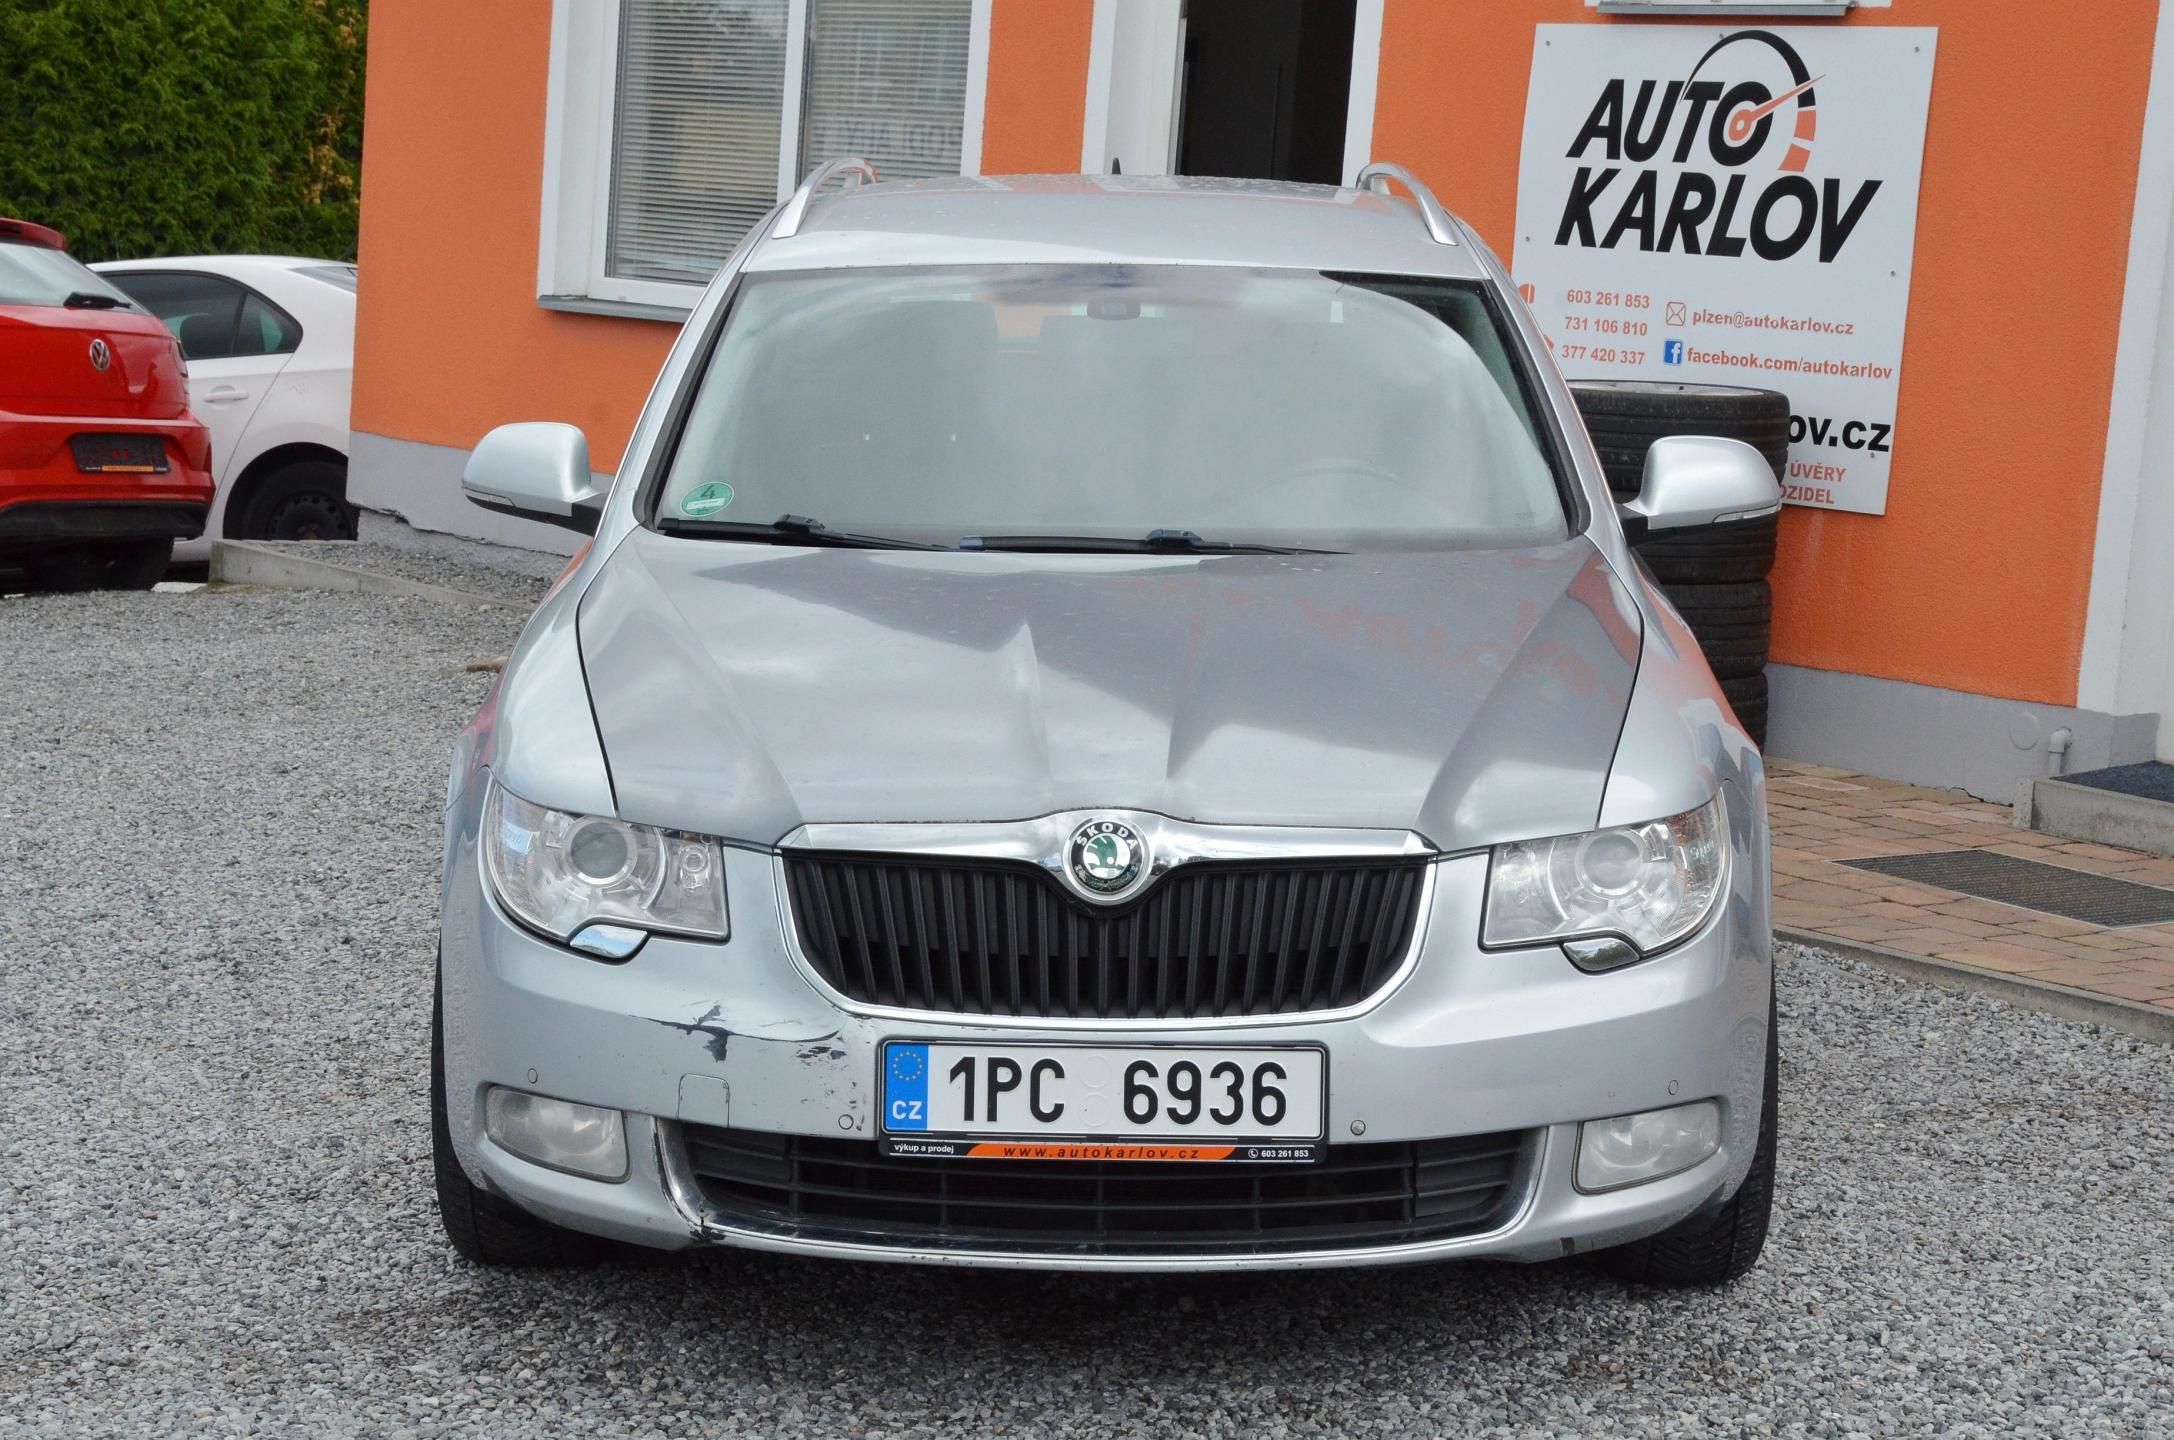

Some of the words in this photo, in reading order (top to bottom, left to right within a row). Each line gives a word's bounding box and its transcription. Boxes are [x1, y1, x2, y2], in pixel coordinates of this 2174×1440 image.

[1565, 78, 1774, 167] AUTO
[1554, 166, 1883, 263] KARLOV
[1566, 289, 1592, 304] 603
[1596, 291, 1620, 306] 261
[1624, 294, 1650, 309] 853
[1564, 316, 1588, 332] 731
[1594, 318, 1619, 334] 106
[1622, 321, 1648, 336] 810
[1691, 308, 1854, 336] plzen@autokarlov.cz
[1561, 344, 1588, 360] 377
[1590, 347, 1617, 363] 420
[1620, 350, 1646, 366] 337
[1687, 347, 1893, 379] facebook.com/autokarlov
[700, 484, 716, 499] 4
[949, 1056, 1065, 1123] 1PC
[1123, 1060, 1288, 1126] 6936
[892, 1100, 922, 1120] CZ
[894, 1143, 919, 1153] výkup
[928, 1144, 954, 1154] prodej
[1004, 1146, 1200, 1160] www.autokarlov.cz
[1261, 1149, 1276, 1158] 603
[1277, 1149, 1292, 1158] 261
[1294, 1149, 1309, 1158] 853
